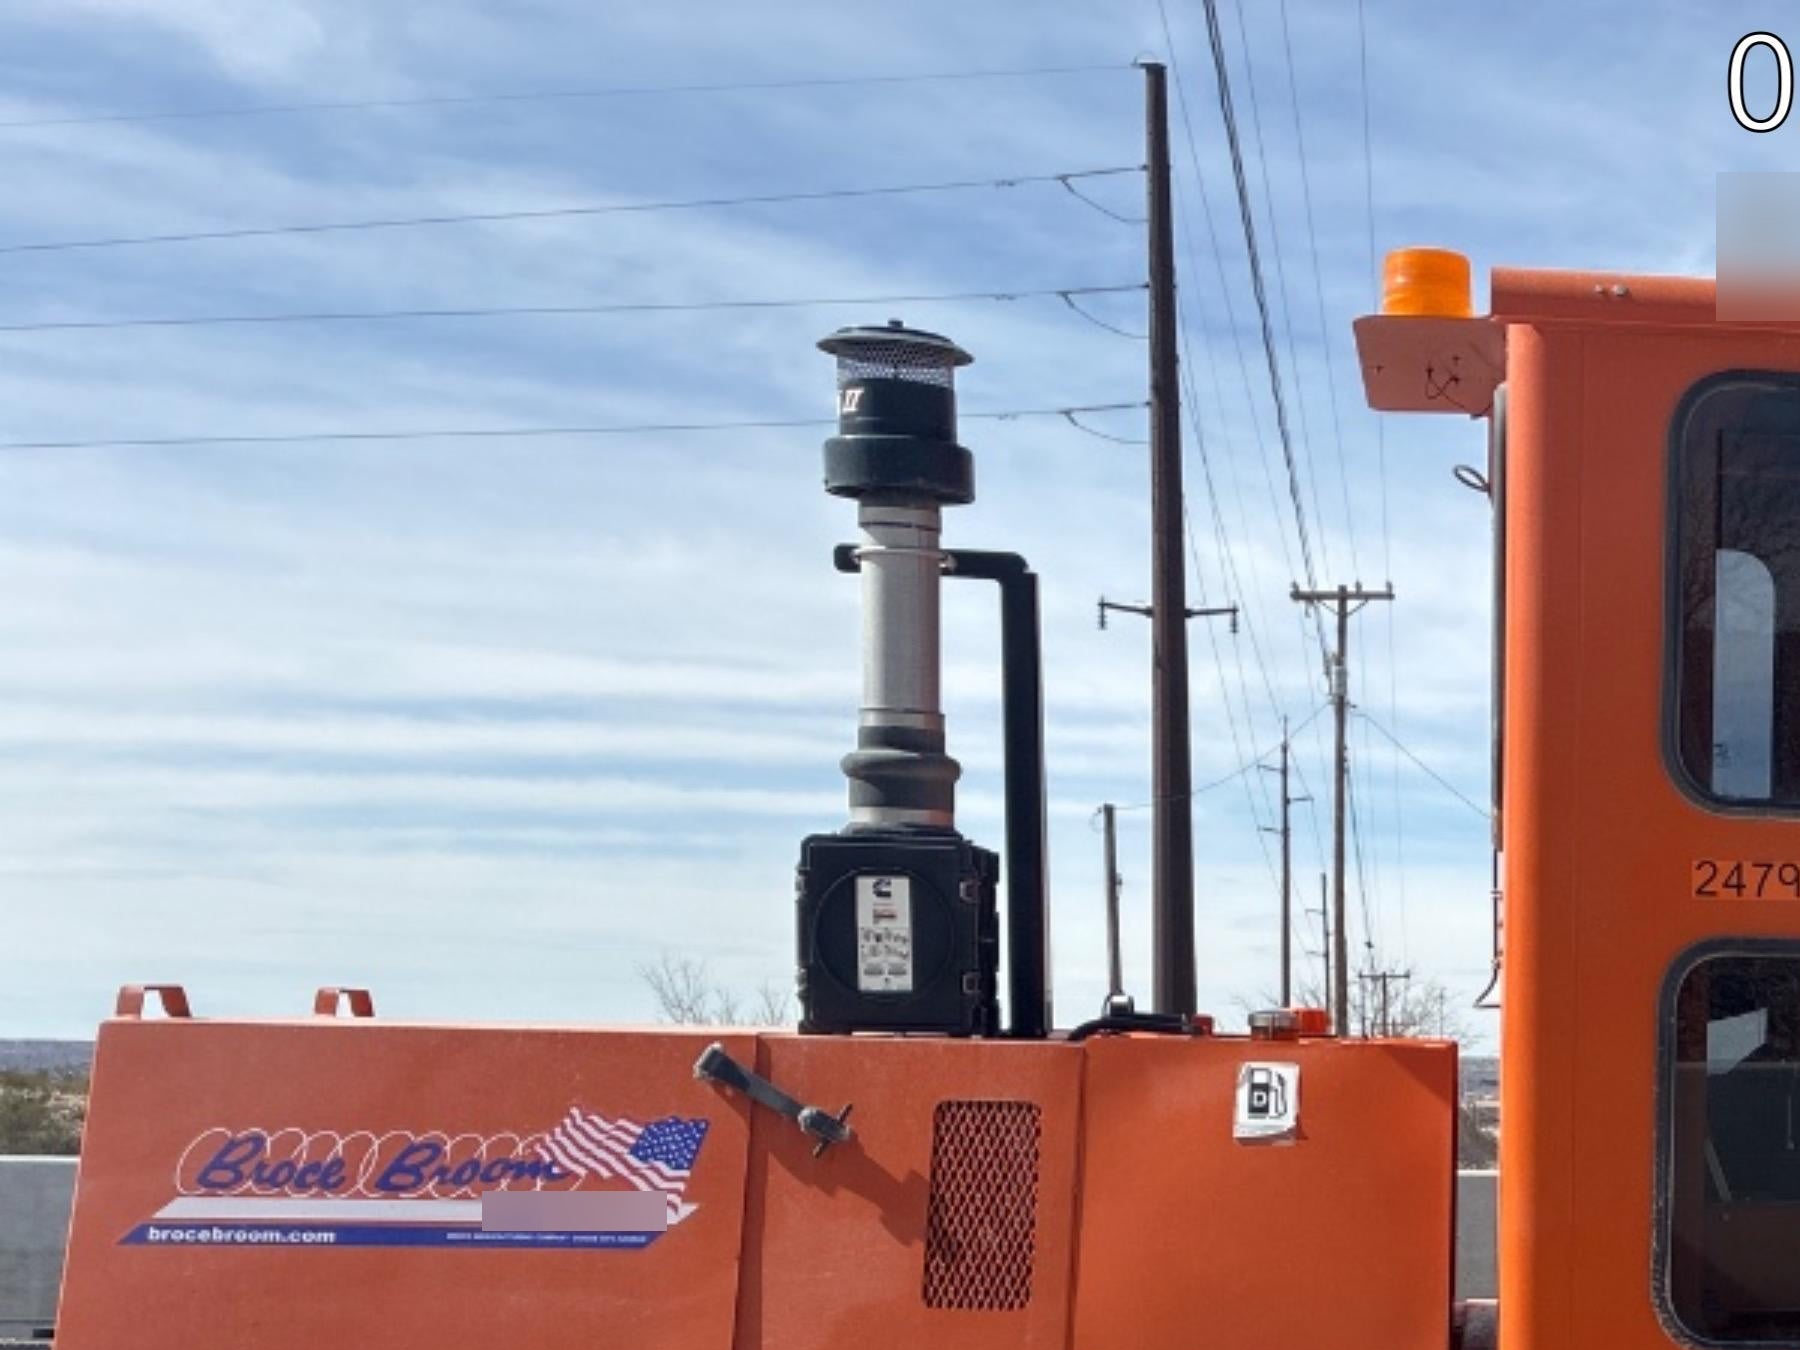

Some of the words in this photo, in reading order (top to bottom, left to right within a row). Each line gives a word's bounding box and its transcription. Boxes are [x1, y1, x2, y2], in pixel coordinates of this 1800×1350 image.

[197, 1133, 346, 1190] Broce
[374, 1140, 568, 1191] Broom
[148, 1226, 336, 1244] brocebroom.com
